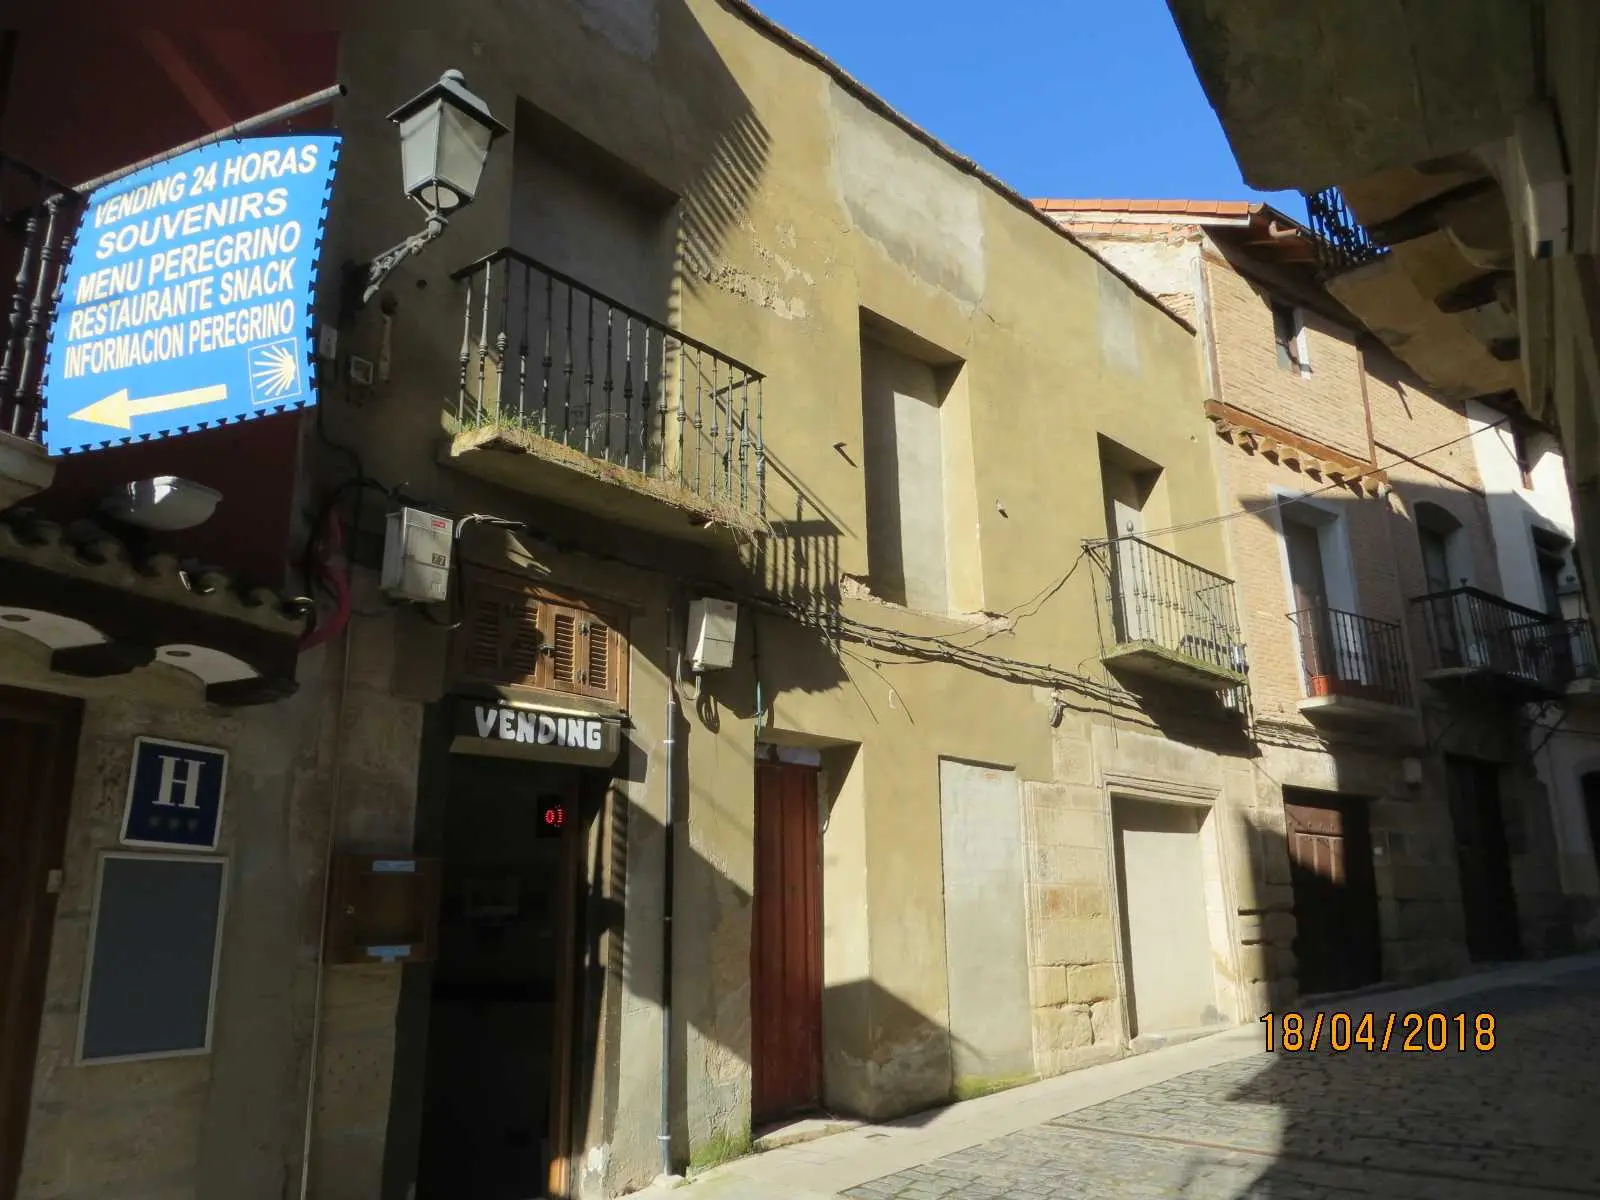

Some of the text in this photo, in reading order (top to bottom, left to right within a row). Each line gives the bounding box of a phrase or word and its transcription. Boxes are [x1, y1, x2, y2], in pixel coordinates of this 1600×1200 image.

[95, 144, 319, 228] VENDING 24 HORAS
[95, 188, 288, 260] SOUVENIRS
[68, 257, 296, 341] RESTAURANTE SNACK
[76, 221, 301, 304] MENU PEREGRINO
[64, 299, 294, 378] INFORMACION PEREGRINO
[475, 707, 602, 750] VENDING
[153, 755, 207, 809] H
